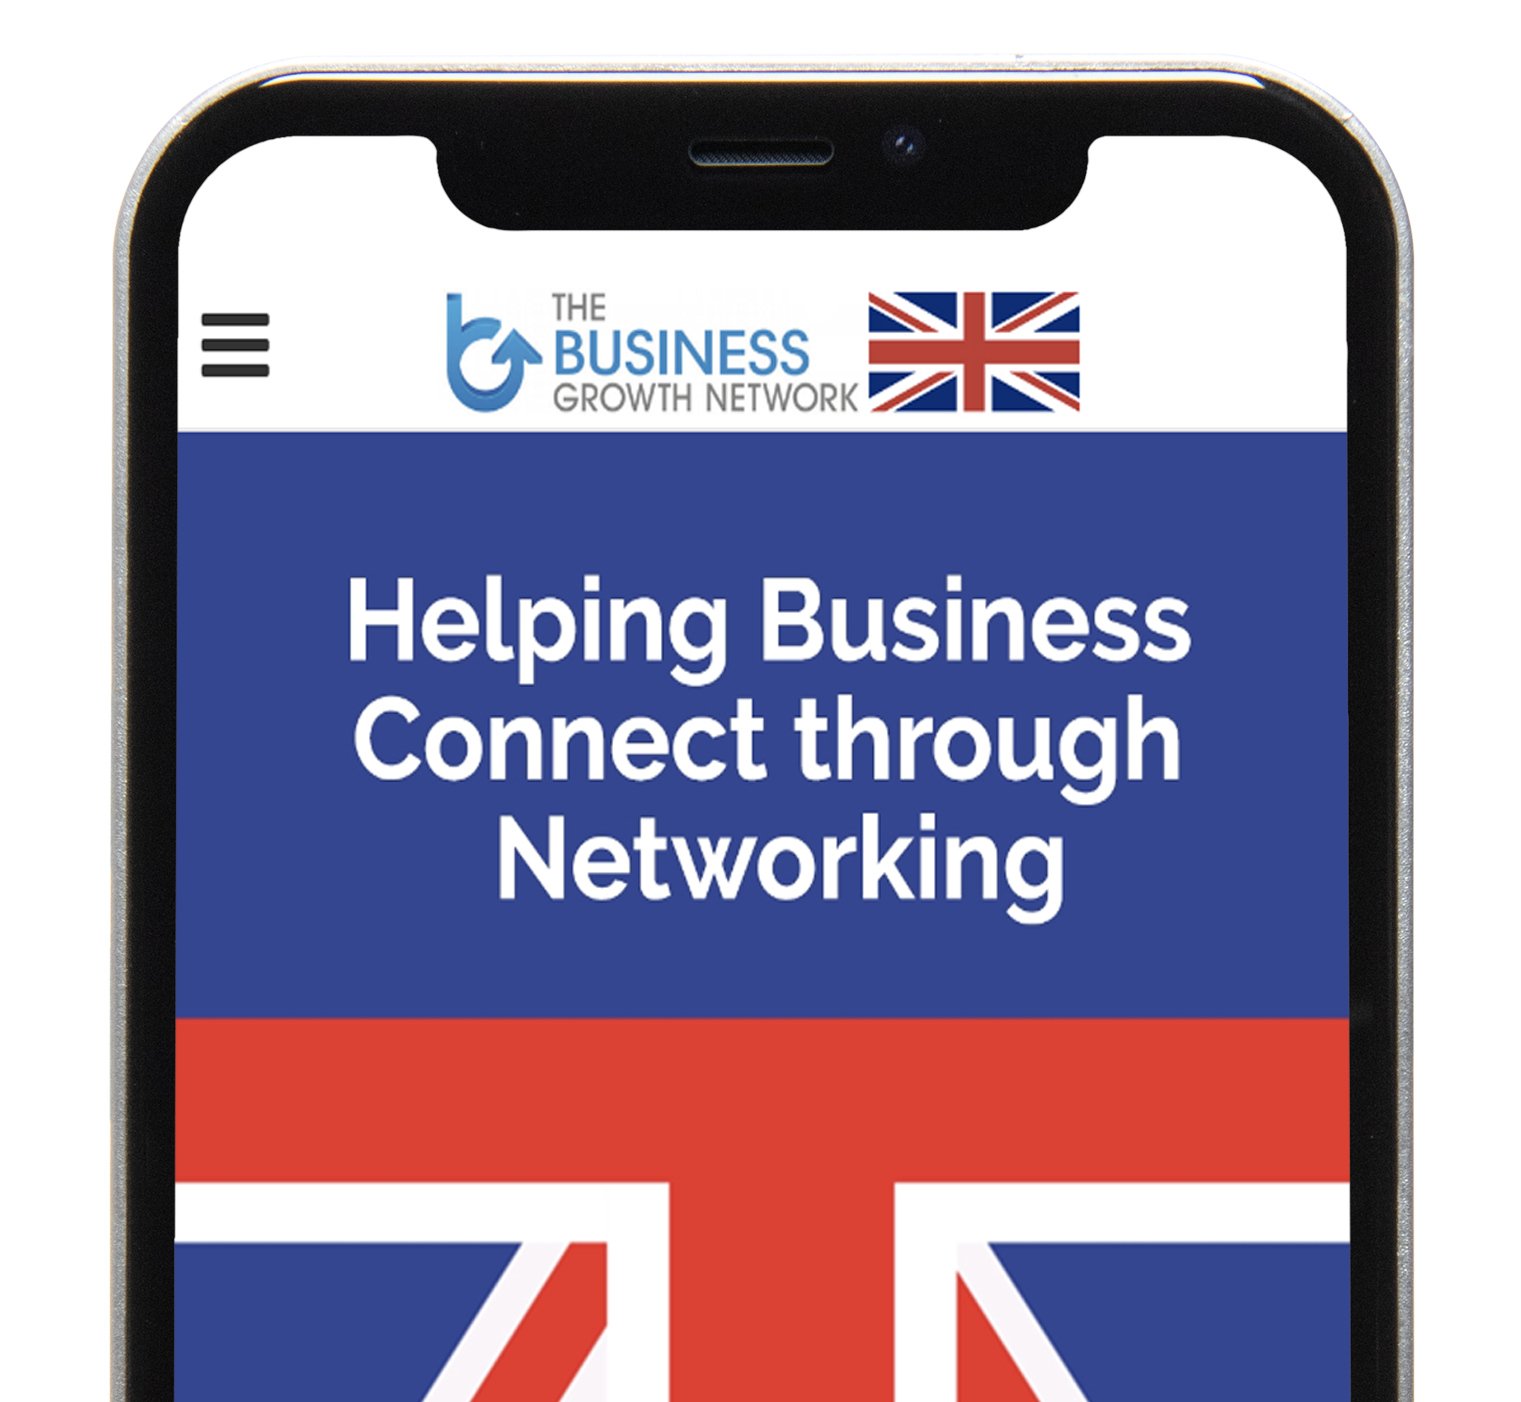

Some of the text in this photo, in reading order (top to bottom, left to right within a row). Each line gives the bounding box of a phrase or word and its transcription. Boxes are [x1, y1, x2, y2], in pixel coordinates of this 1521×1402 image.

[552, 293, 606, 321] THE
[555, 329, 809, 376] BUSINESS
[553, 382, 859, 412] GROWTH NETWORK
[350, 574, 1192, 687] Helping Business
[354, 694, 1179, 806] Connect through
[500, 812, 1063, 925] Networking
